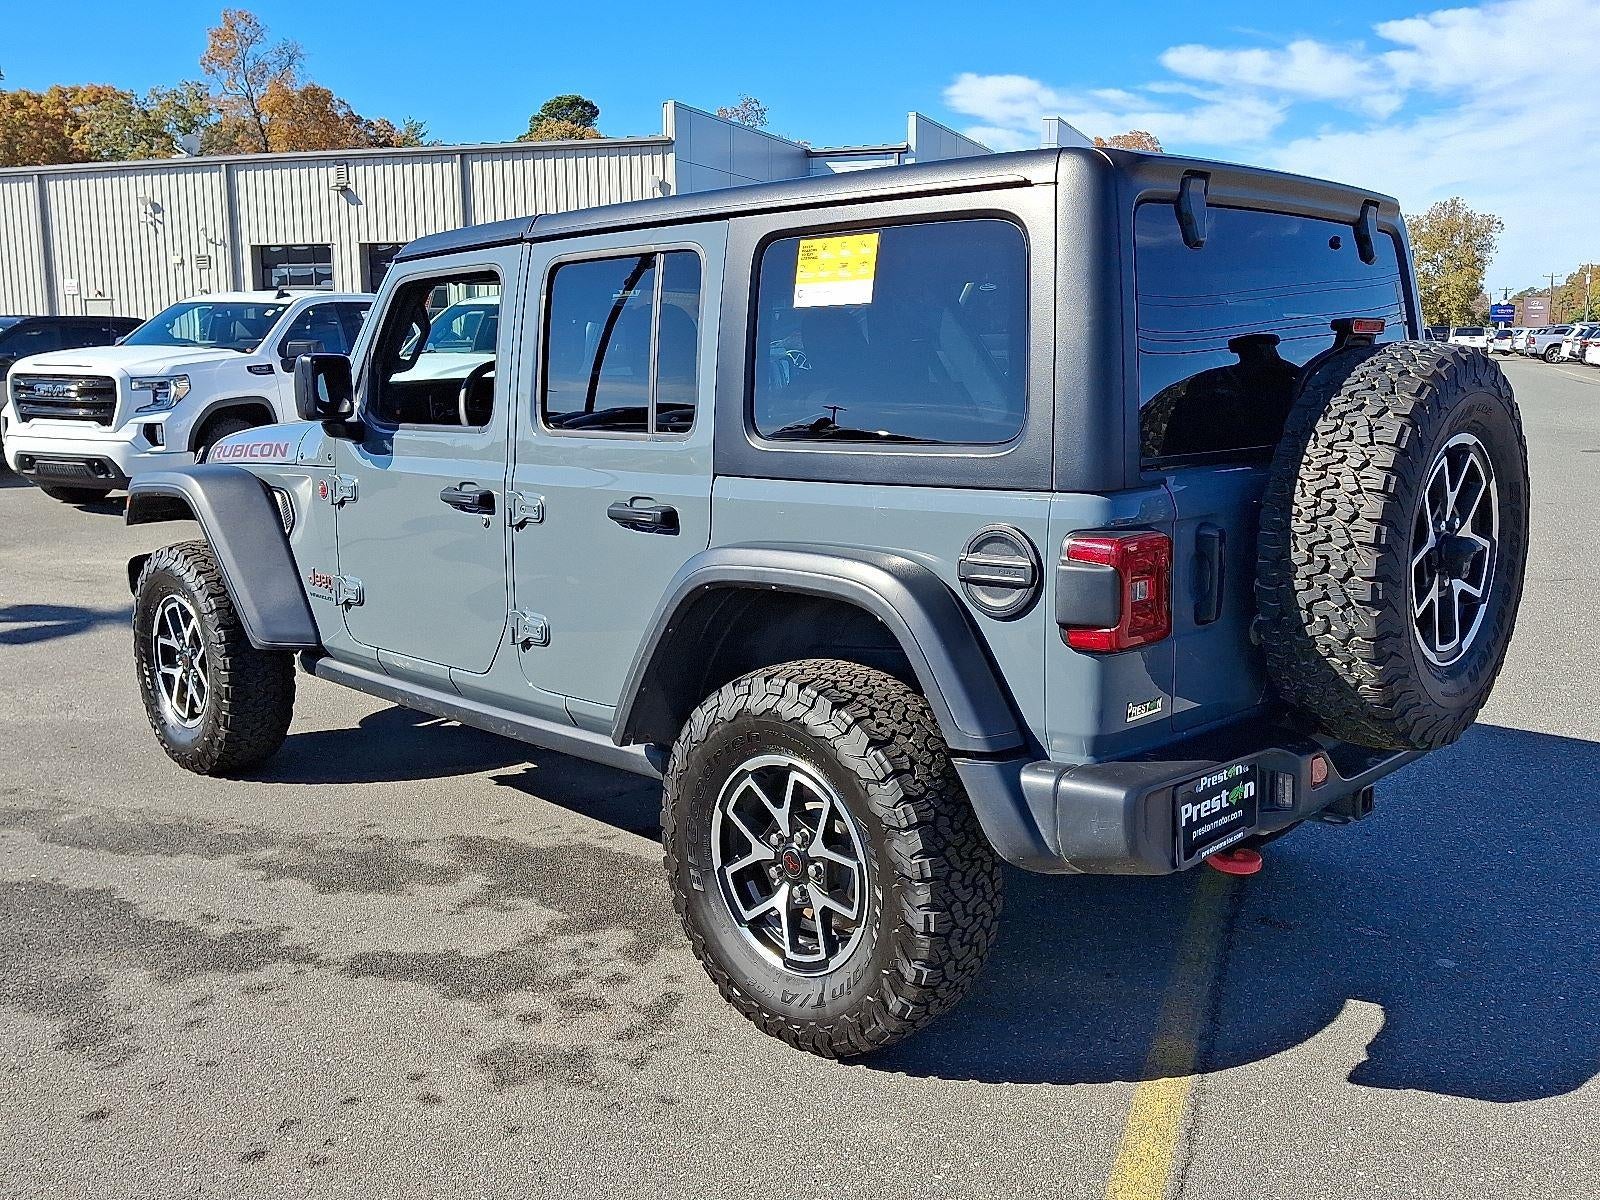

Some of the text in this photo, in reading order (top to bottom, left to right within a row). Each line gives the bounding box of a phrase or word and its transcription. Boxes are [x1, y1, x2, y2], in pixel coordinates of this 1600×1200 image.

[33, 383, 78, 397] GMC
[211, 442, 290, 458] RUBICON
[308, 567, 333, 594] Jeep
[1192, 809, 1243, 841] prestonmotor.com
